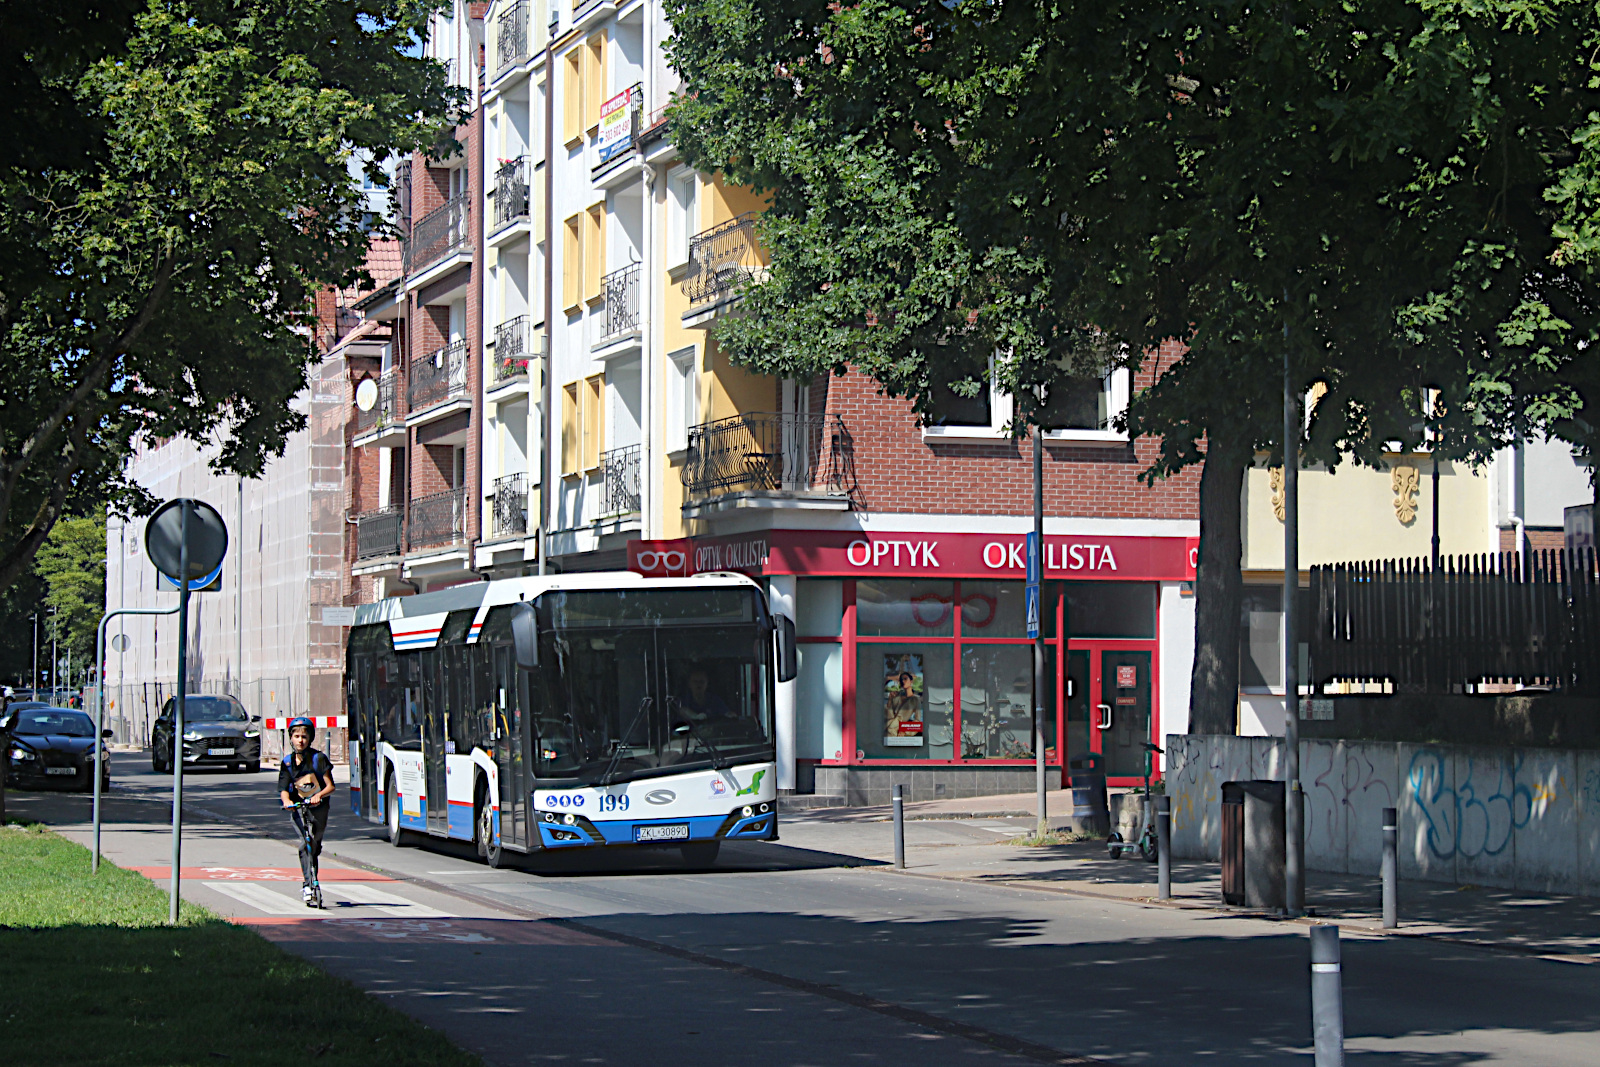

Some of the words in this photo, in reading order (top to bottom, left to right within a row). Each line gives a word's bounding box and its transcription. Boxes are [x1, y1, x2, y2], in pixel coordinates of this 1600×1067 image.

[695, 545, 722, 571] OPTYK
[725, 540, 768, 569] OKULISTA
[847, 540, 939, 568] OPTYK
[983, 541, 1117, 571] OKLISTA
[598, 794, 630, 812] 199
[640, 827, 657, 838] ZKL
[660, 826, 688, 837] 30890
